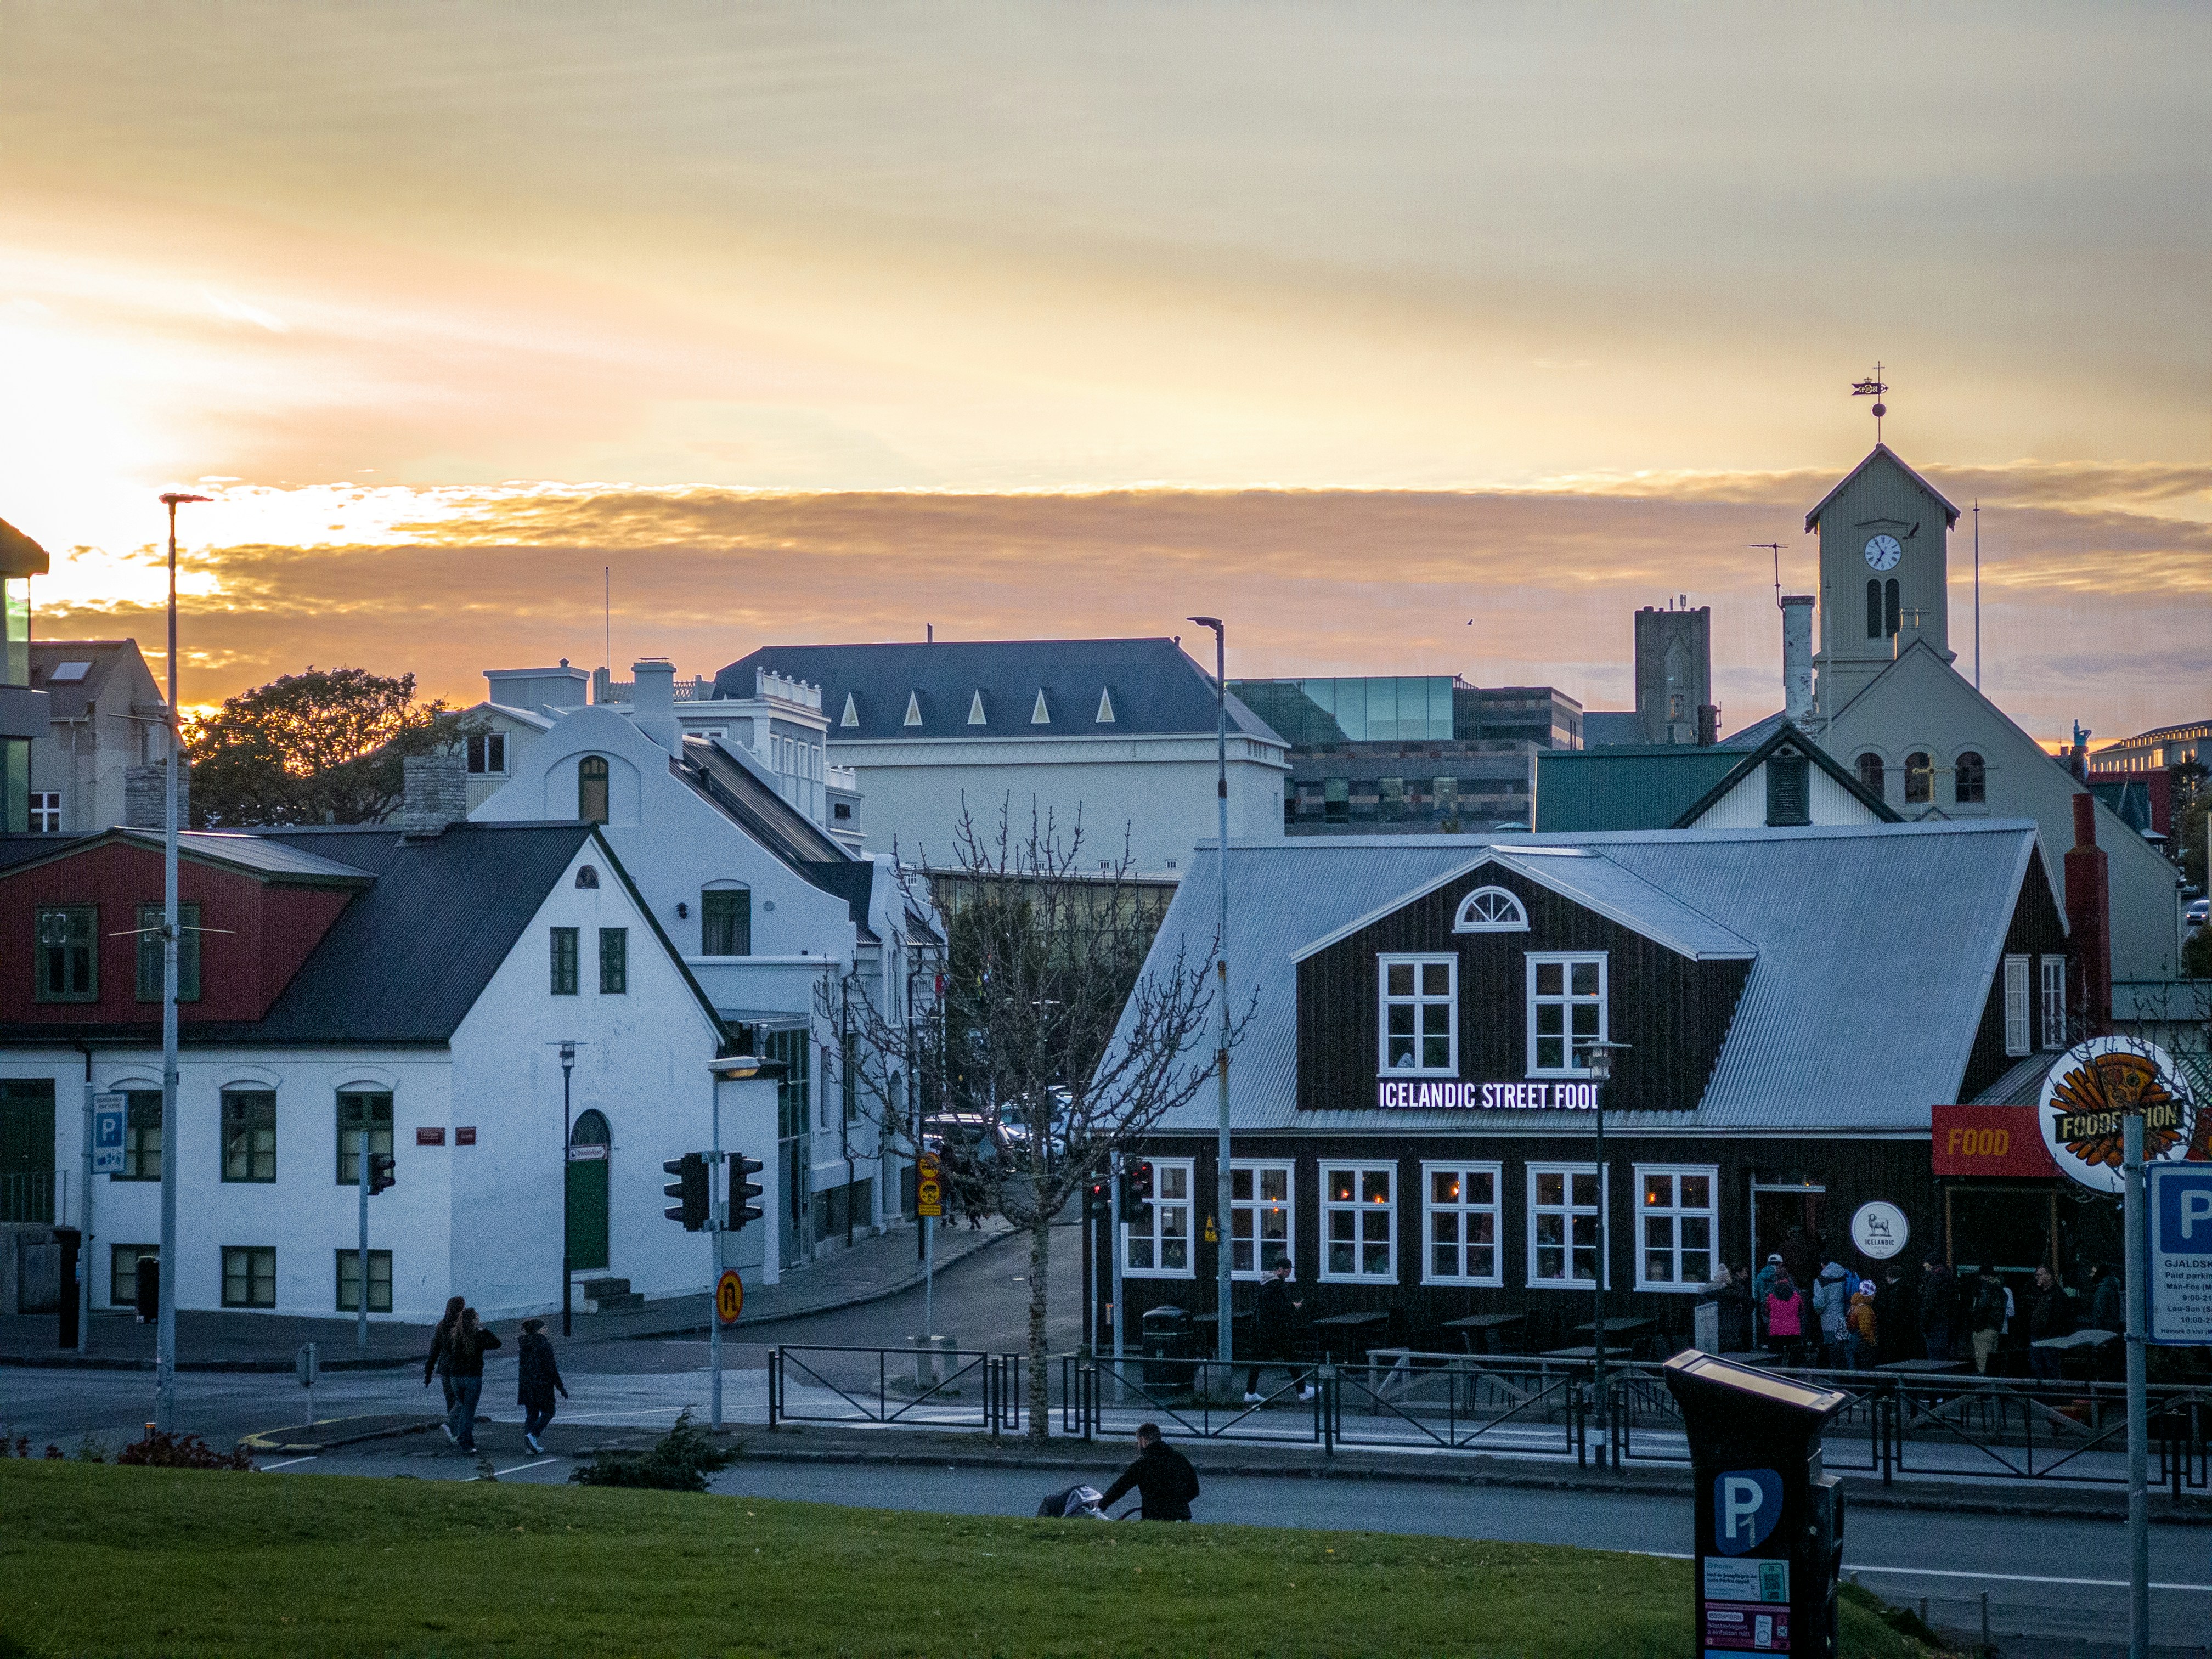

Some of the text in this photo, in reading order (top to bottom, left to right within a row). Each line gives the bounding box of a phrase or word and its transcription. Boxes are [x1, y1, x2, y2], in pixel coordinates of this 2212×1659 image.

[1379, 1082, 1476, 1107] ICELANDIC
[1482, 1083, 1549, 1109] STREET
[103, 1118, 116, 1141] P
[2063, 1105, 2177, 1138] FOODFION
[1948, 1128, 2010, 1156] FOOD
[2181, 1190, 2212, 1239] P
[1724, 1477, 1763, 1538] P
